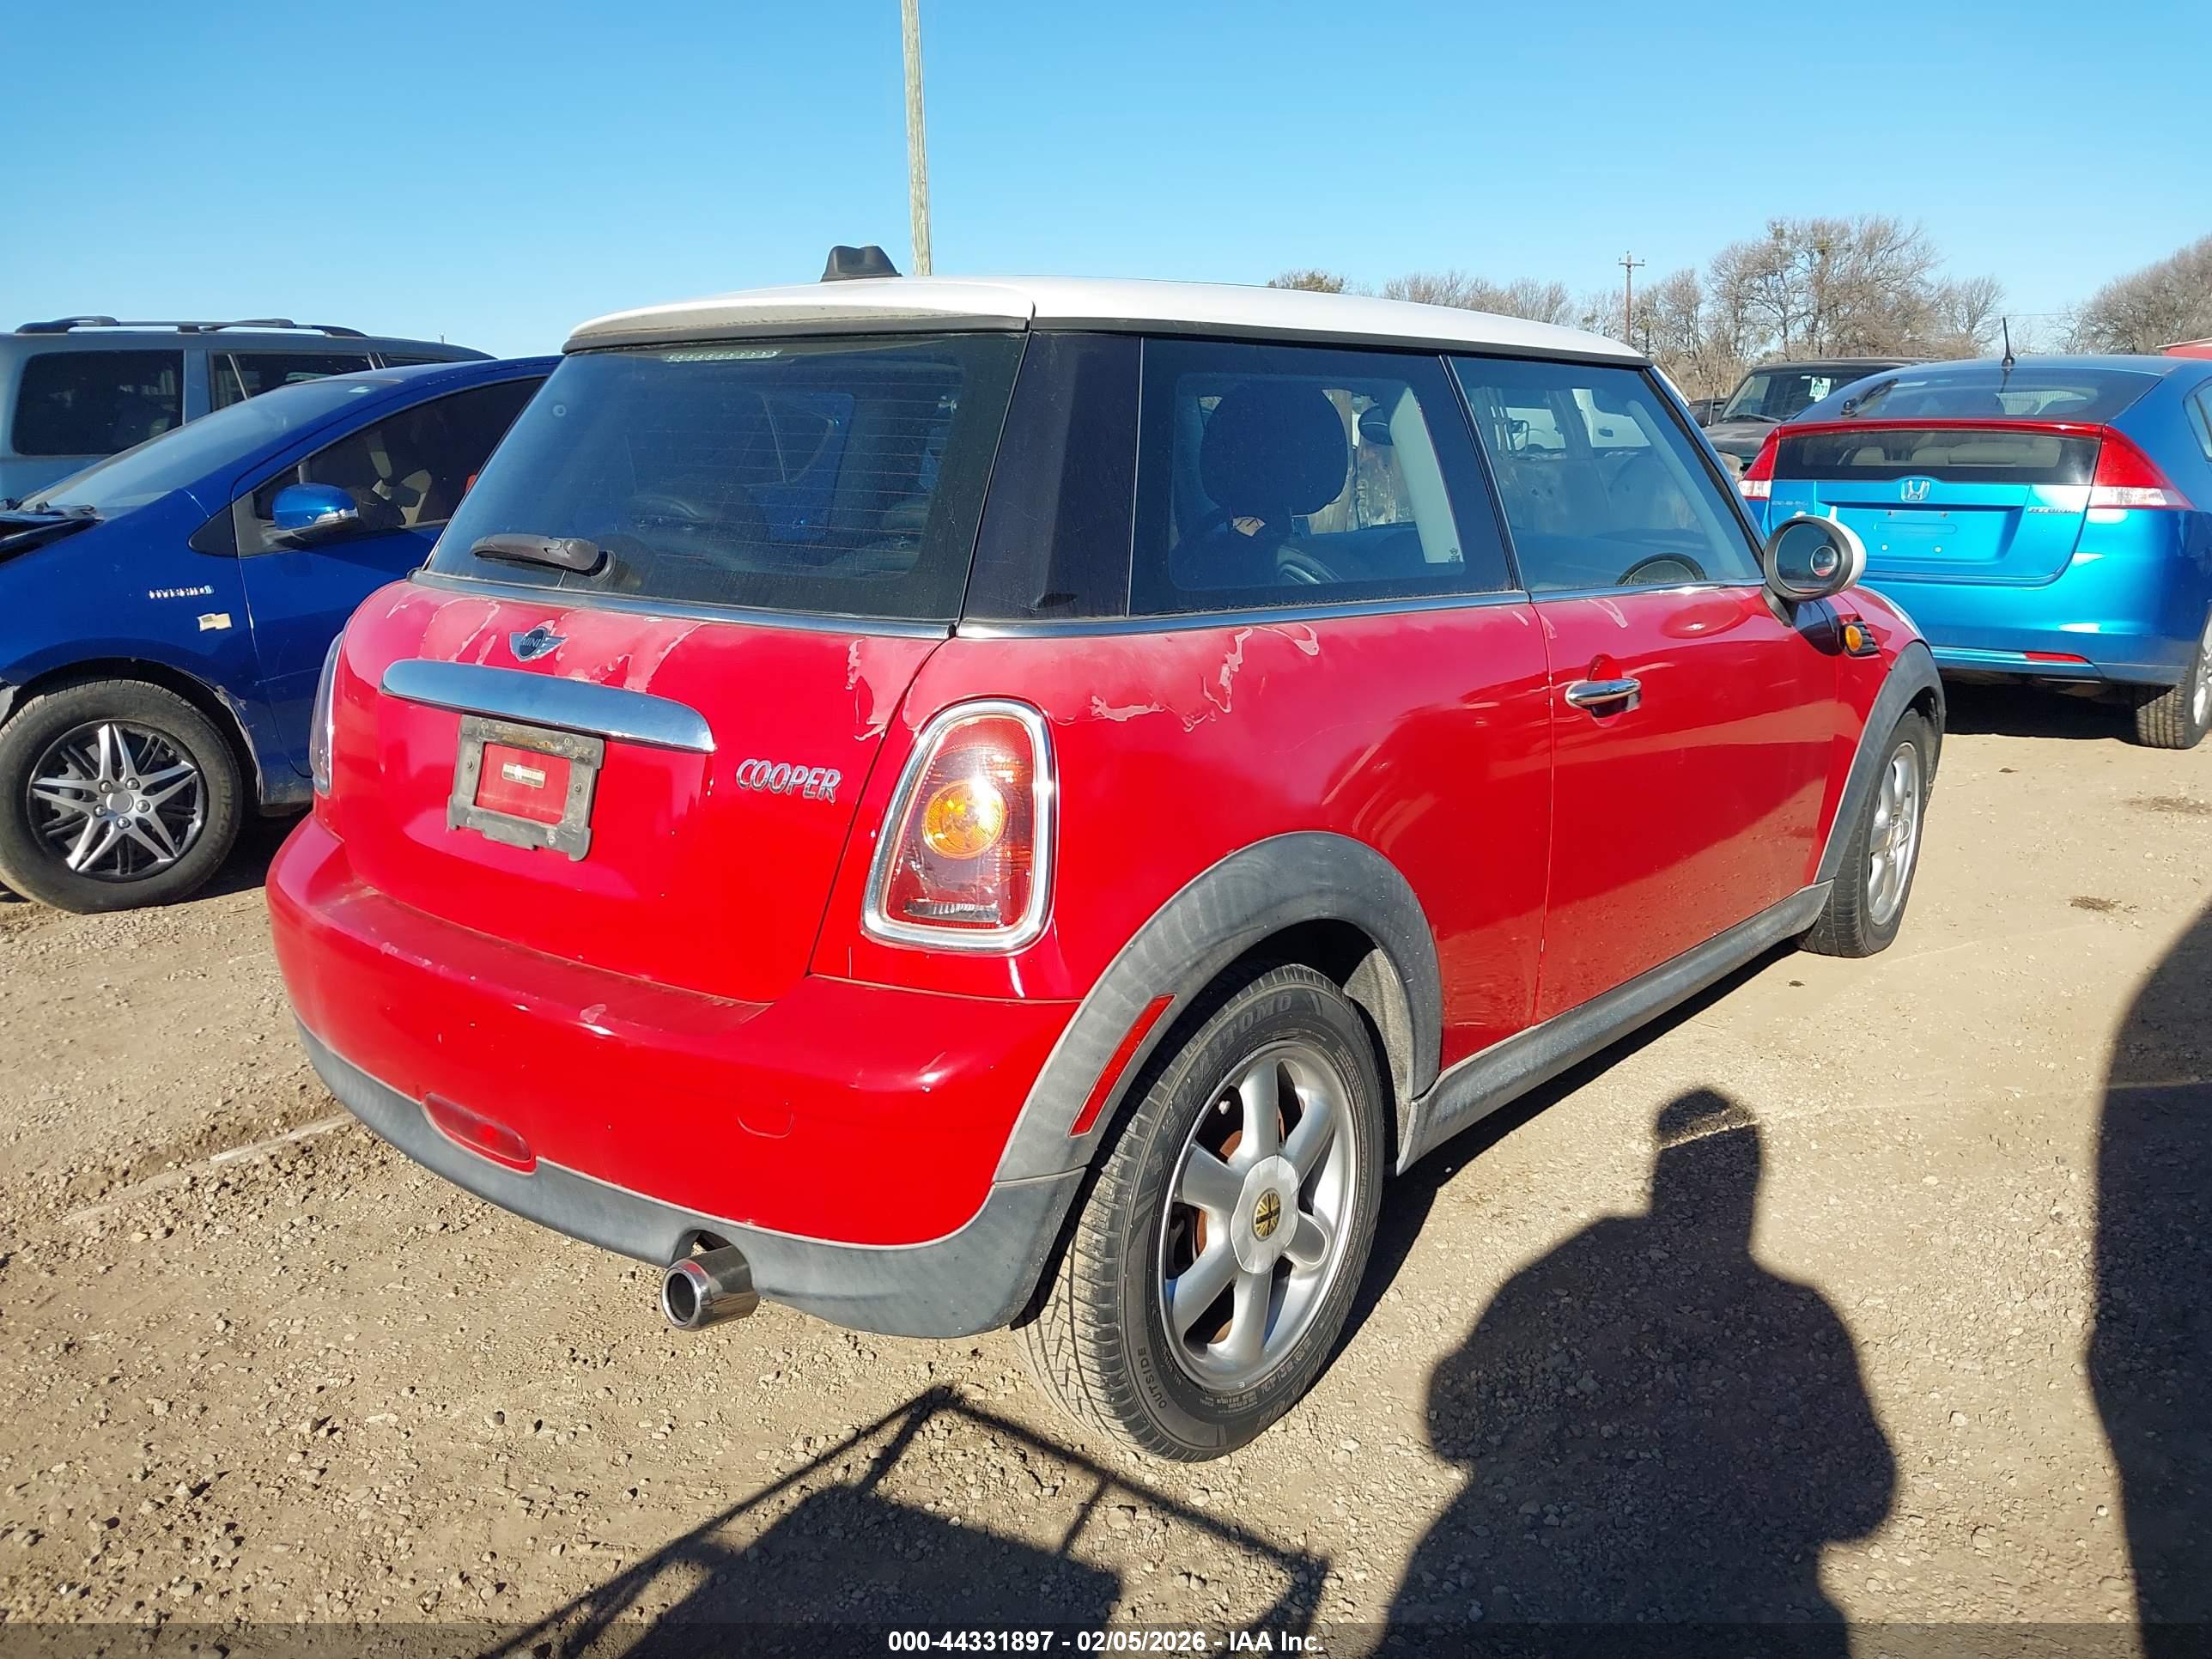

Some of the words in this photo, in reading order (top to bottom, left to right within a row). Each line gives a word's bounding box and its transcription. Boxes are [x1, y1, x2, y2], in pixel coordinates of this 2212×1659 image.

[520, 637, 542, 647] MINI
[736, 758, 841, 804] COOPER
[1137, 1346, 1167, 1409] OUTSIDE
